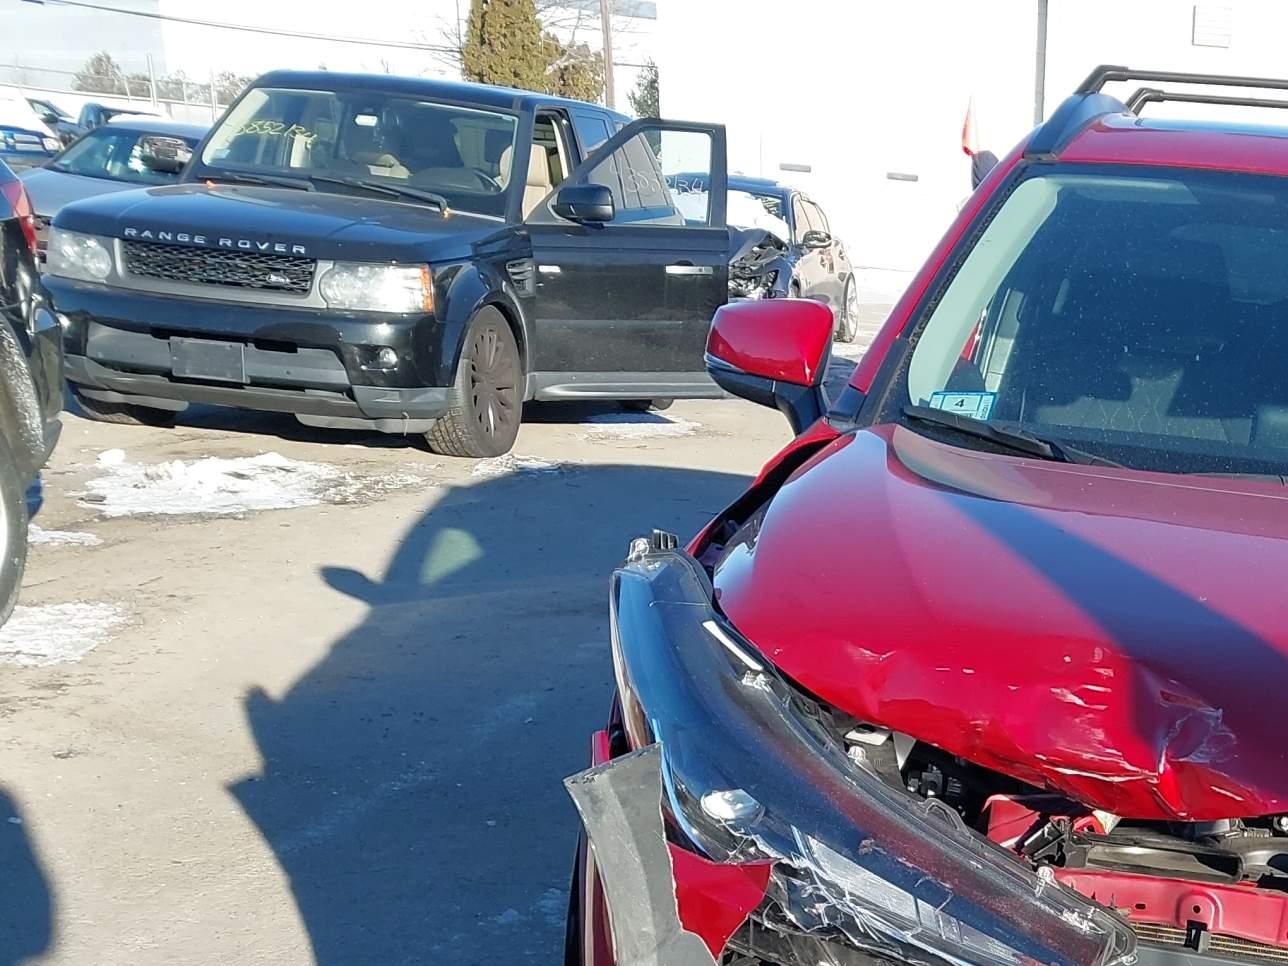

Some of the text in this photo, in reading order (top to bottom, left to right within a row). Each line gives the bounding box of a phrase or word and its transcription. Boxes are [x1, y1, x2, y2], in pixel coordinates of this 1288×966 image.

[124, 227, 306, 254] RANGE ROVER
[954, 398, 965, 408] 4
